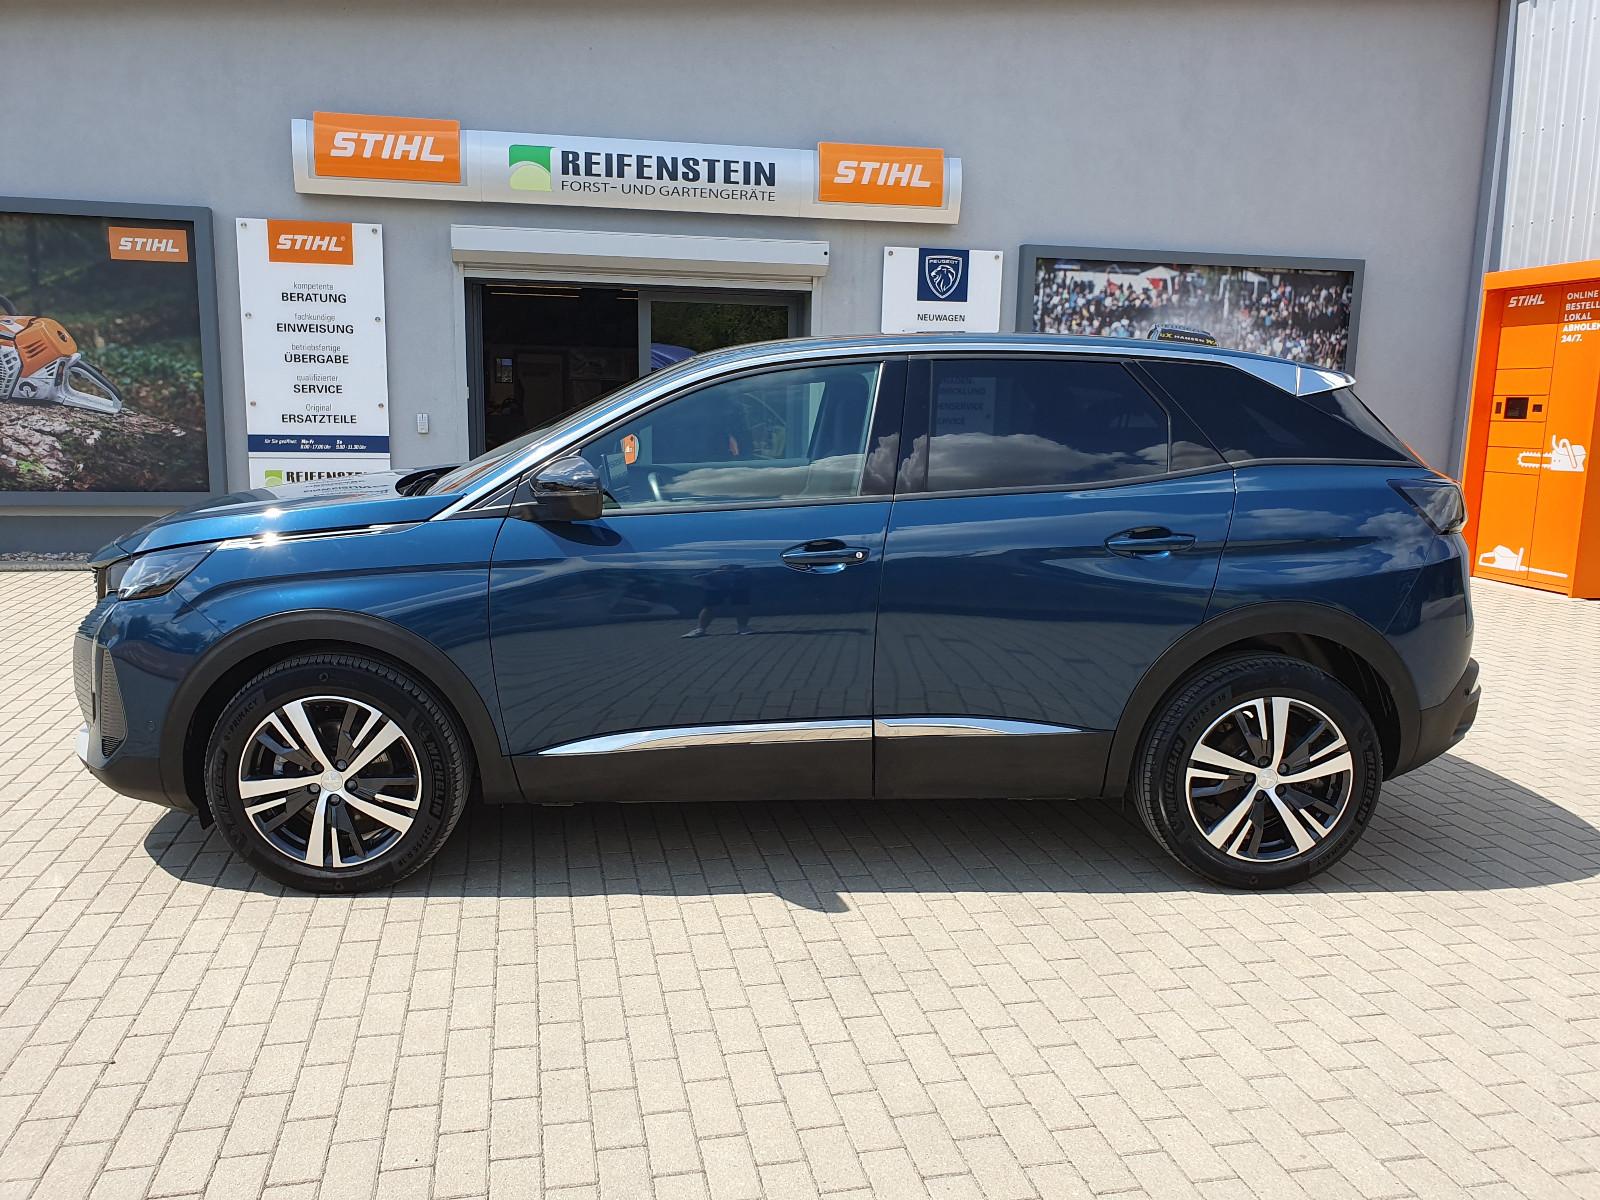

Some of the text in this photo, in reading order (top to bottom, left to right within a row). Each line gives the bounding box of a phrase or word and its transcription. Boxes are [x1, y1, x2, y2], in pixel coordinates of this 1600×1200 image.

[330, 131, 445, 162] STIHL
[560, 150, 776, 187] REIFENSTEIN
[833, 160, 931, 188] STIHL
[560, 180, 776, 202] FORST- UND GARTENGERÄTE
[118, 237, 180, 253] STIHL
[276, 234, 343, 252] STIHL
[293, 281, 334, 291] kompetente
[281, 292, 347, 304] BERATUNG
[1508, 294, 1545, 308] STIHL
[1567, 290, 1599, 300] ONLINE
[294, 312, 336, 323] fachkundige
[917, 313, 966, 322] NEUWAGEN
[1564, 312, 1592, 322] LOKAL
[276, 322, 354, 335] EINWEISUNG
[1561, 333, 1583, 344] 24/7.
[284, 352, 349, 365] ÜBERGABE
[293, 384, 343, 395] SERVICE
[305, 404, 332, 413] Original
[281, 414, 357, 425] ERSATZTEILE
